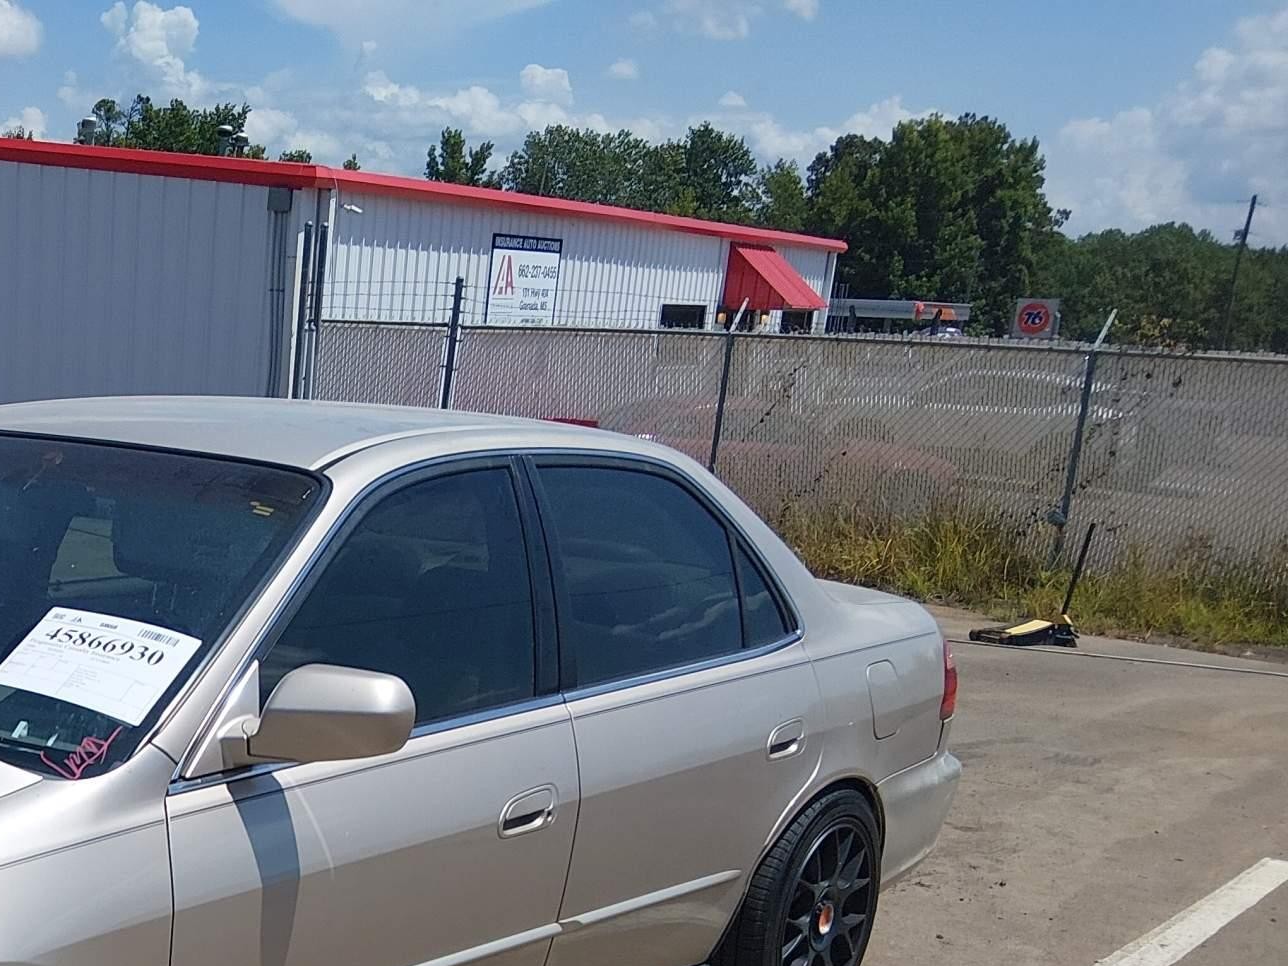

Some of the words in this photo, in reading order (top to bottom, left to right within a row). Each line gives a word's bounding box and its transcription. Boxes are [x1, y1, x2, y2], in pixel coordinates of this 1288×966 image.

[495, 236, 523, 249] INSURANCE
[523, 239, 537, 249] AUTO
[538, 241, 560, 251] AUCTIONS
[1023, 310, 1045, 326] 76
[45, 627, 165, 666] 45866930
